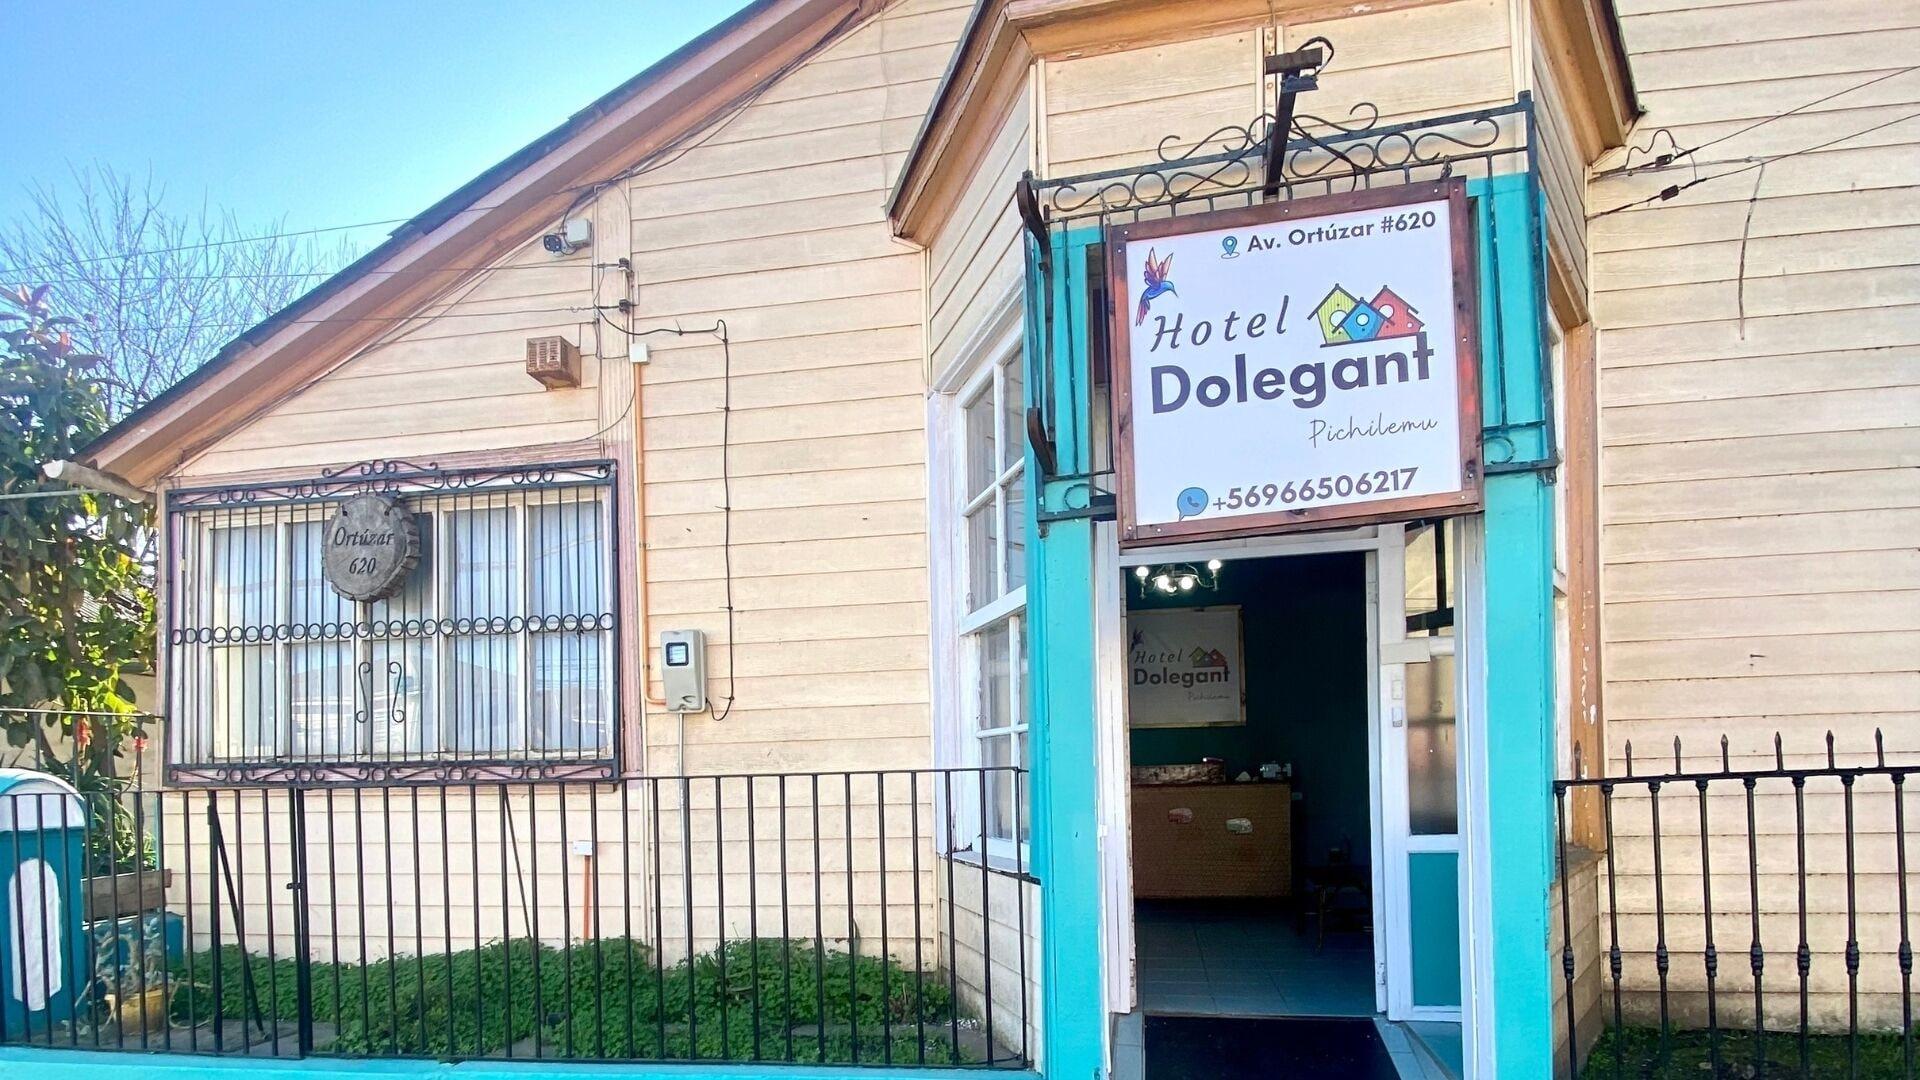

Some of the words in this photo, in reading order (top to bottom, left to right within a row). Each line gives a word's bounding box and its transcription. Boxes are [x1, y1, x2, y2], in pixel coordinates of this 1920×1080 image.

[1247, 234, 1282, 252] Av.
[1288, 222, 1375, 246] Ortúzar
[1381, 210, 1436, 234] #620
[1150, 295, 1290, 352] Hotel
[1150, 331, 1435, 414] Dolegant
[1308, 412, 1439, 448] Pichilemu
[1212, 466, 1419, 511] +56966506217
[334, 526, 395, 546] Ortúzar
[348, 557, 377, 575] 620
[1134, 648, 1183, 665] Hotel
[1133, 665, 1231, 688] Dolegant
